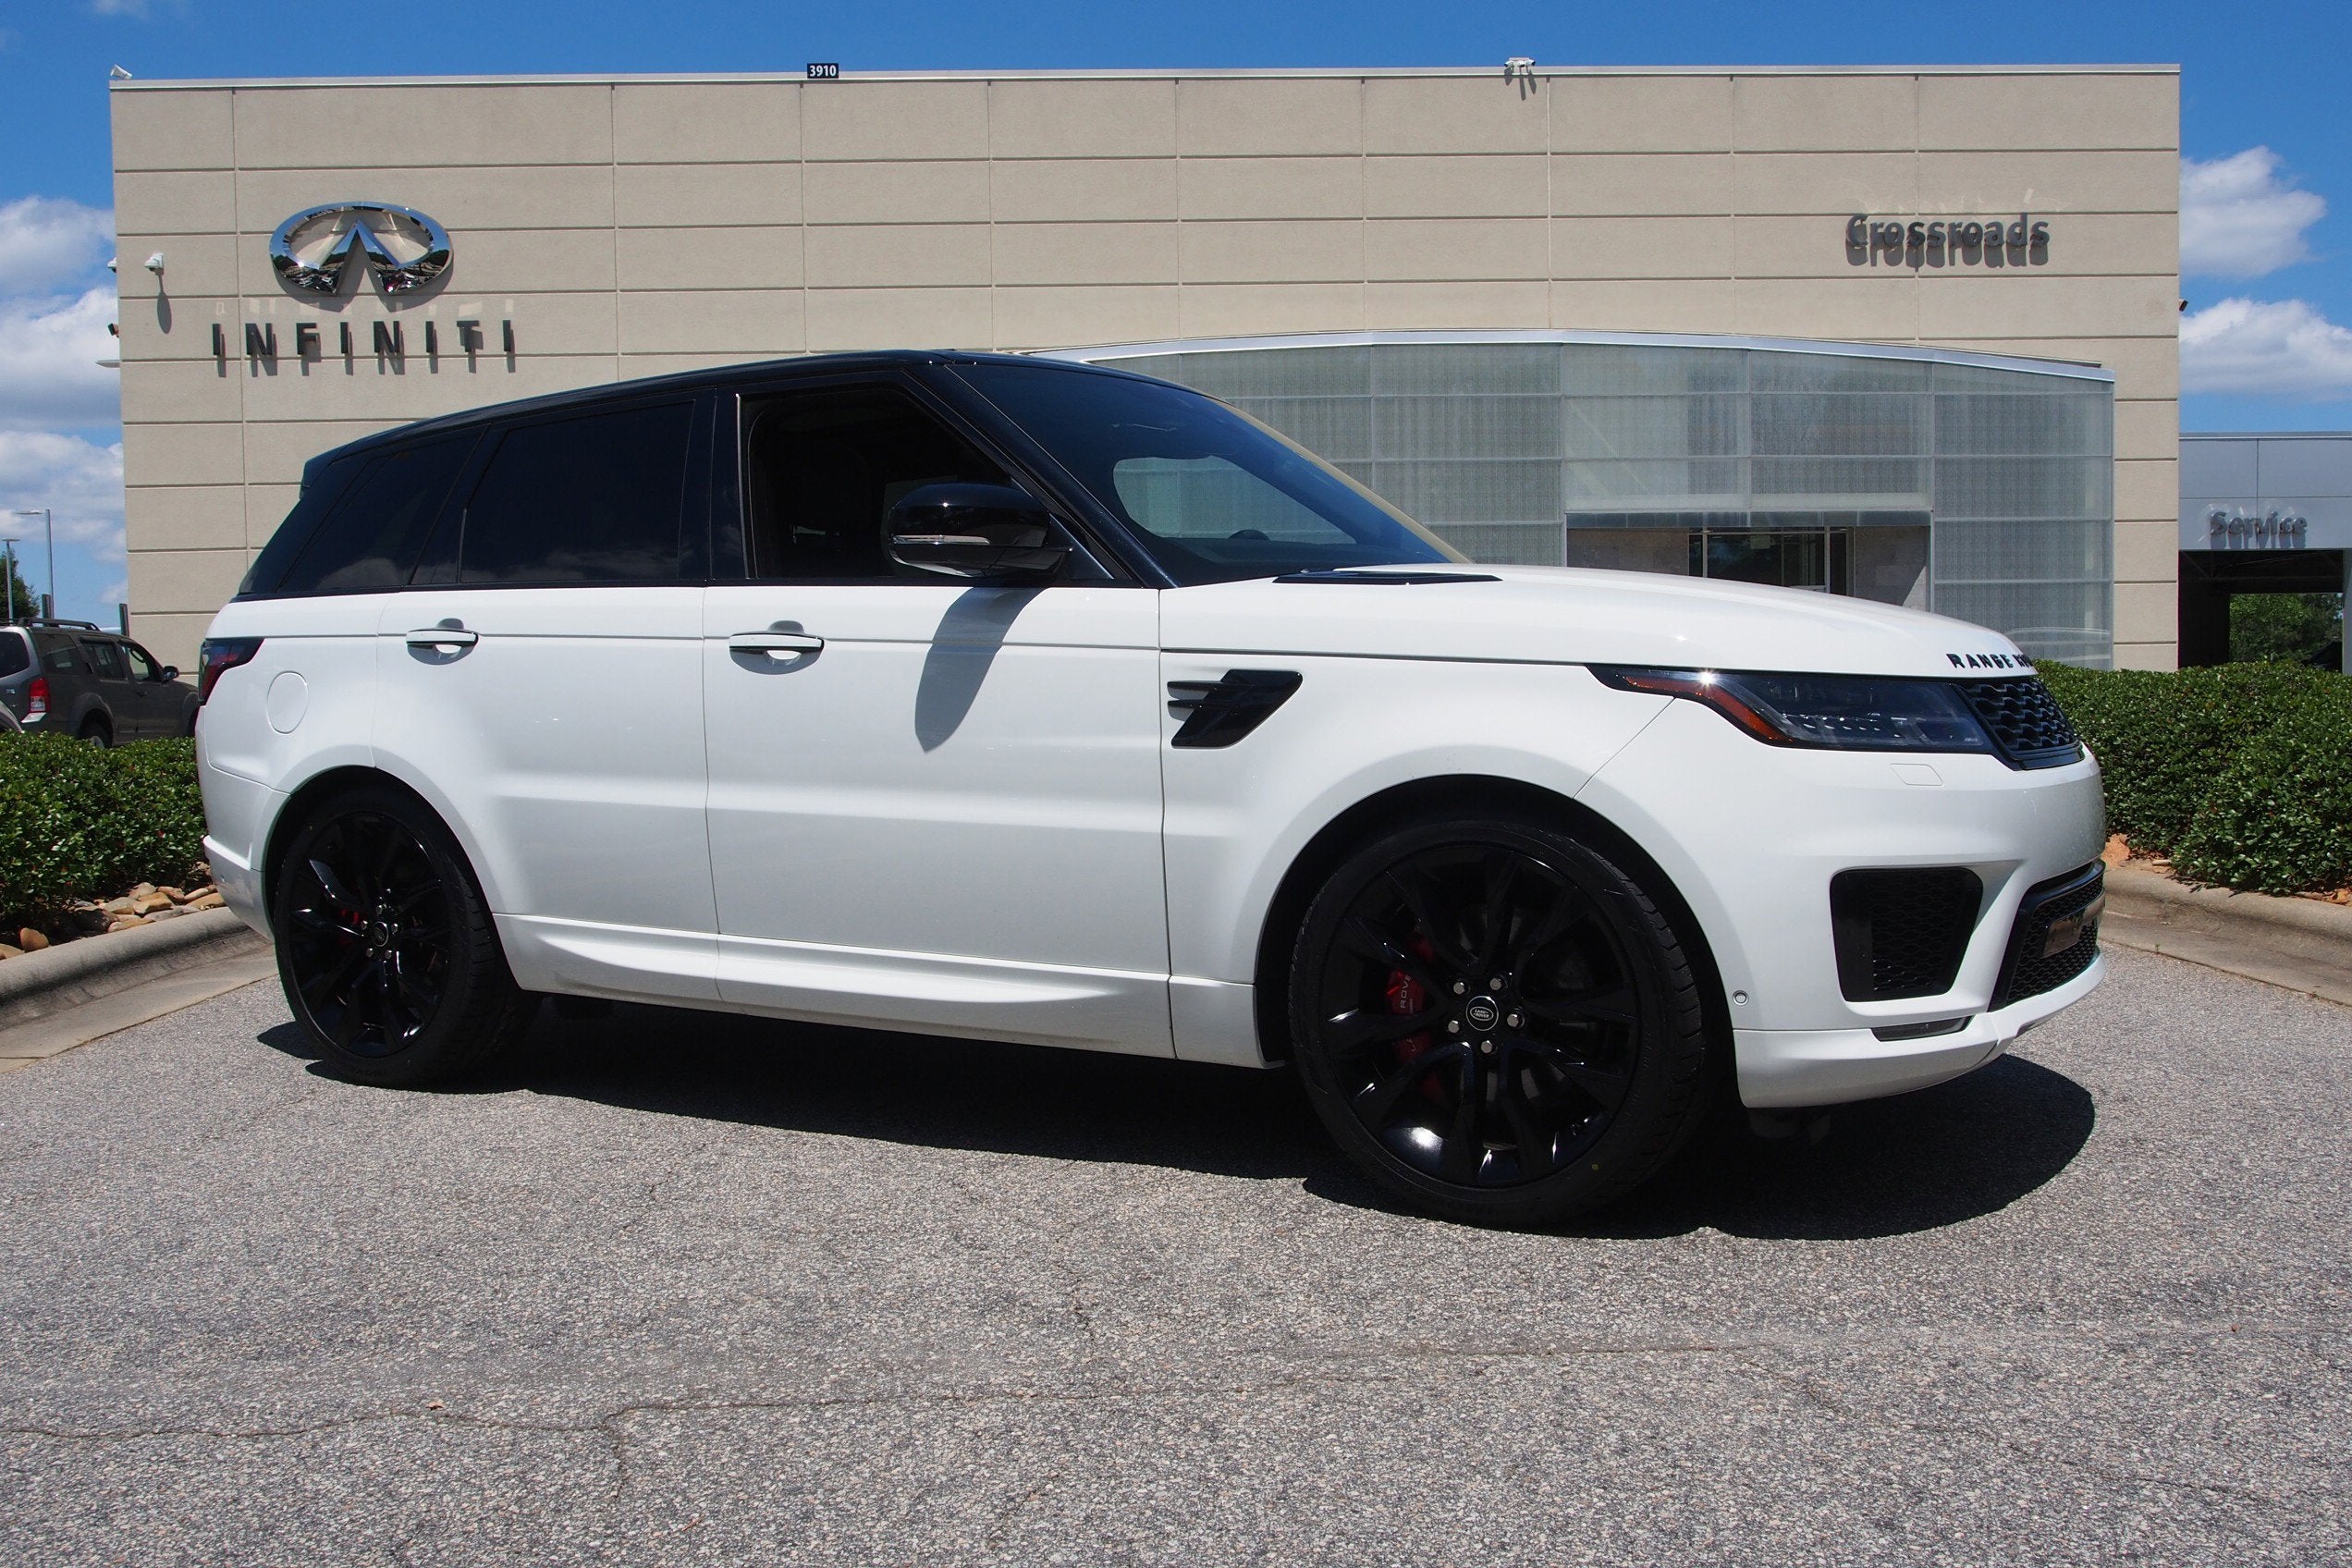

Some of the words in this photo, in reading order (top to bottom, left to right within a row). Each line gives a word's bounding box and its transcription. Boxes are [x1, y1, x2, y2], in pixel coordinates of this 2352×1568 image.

[809, 65, 837, 77] 3910
[1845, 213, 2050, 248] Crossroads
[212, 319, 513, 356] INFINITI
[2210, 510, 2308, 535] Service
[1946, 654, 2014, 668] RANGE
